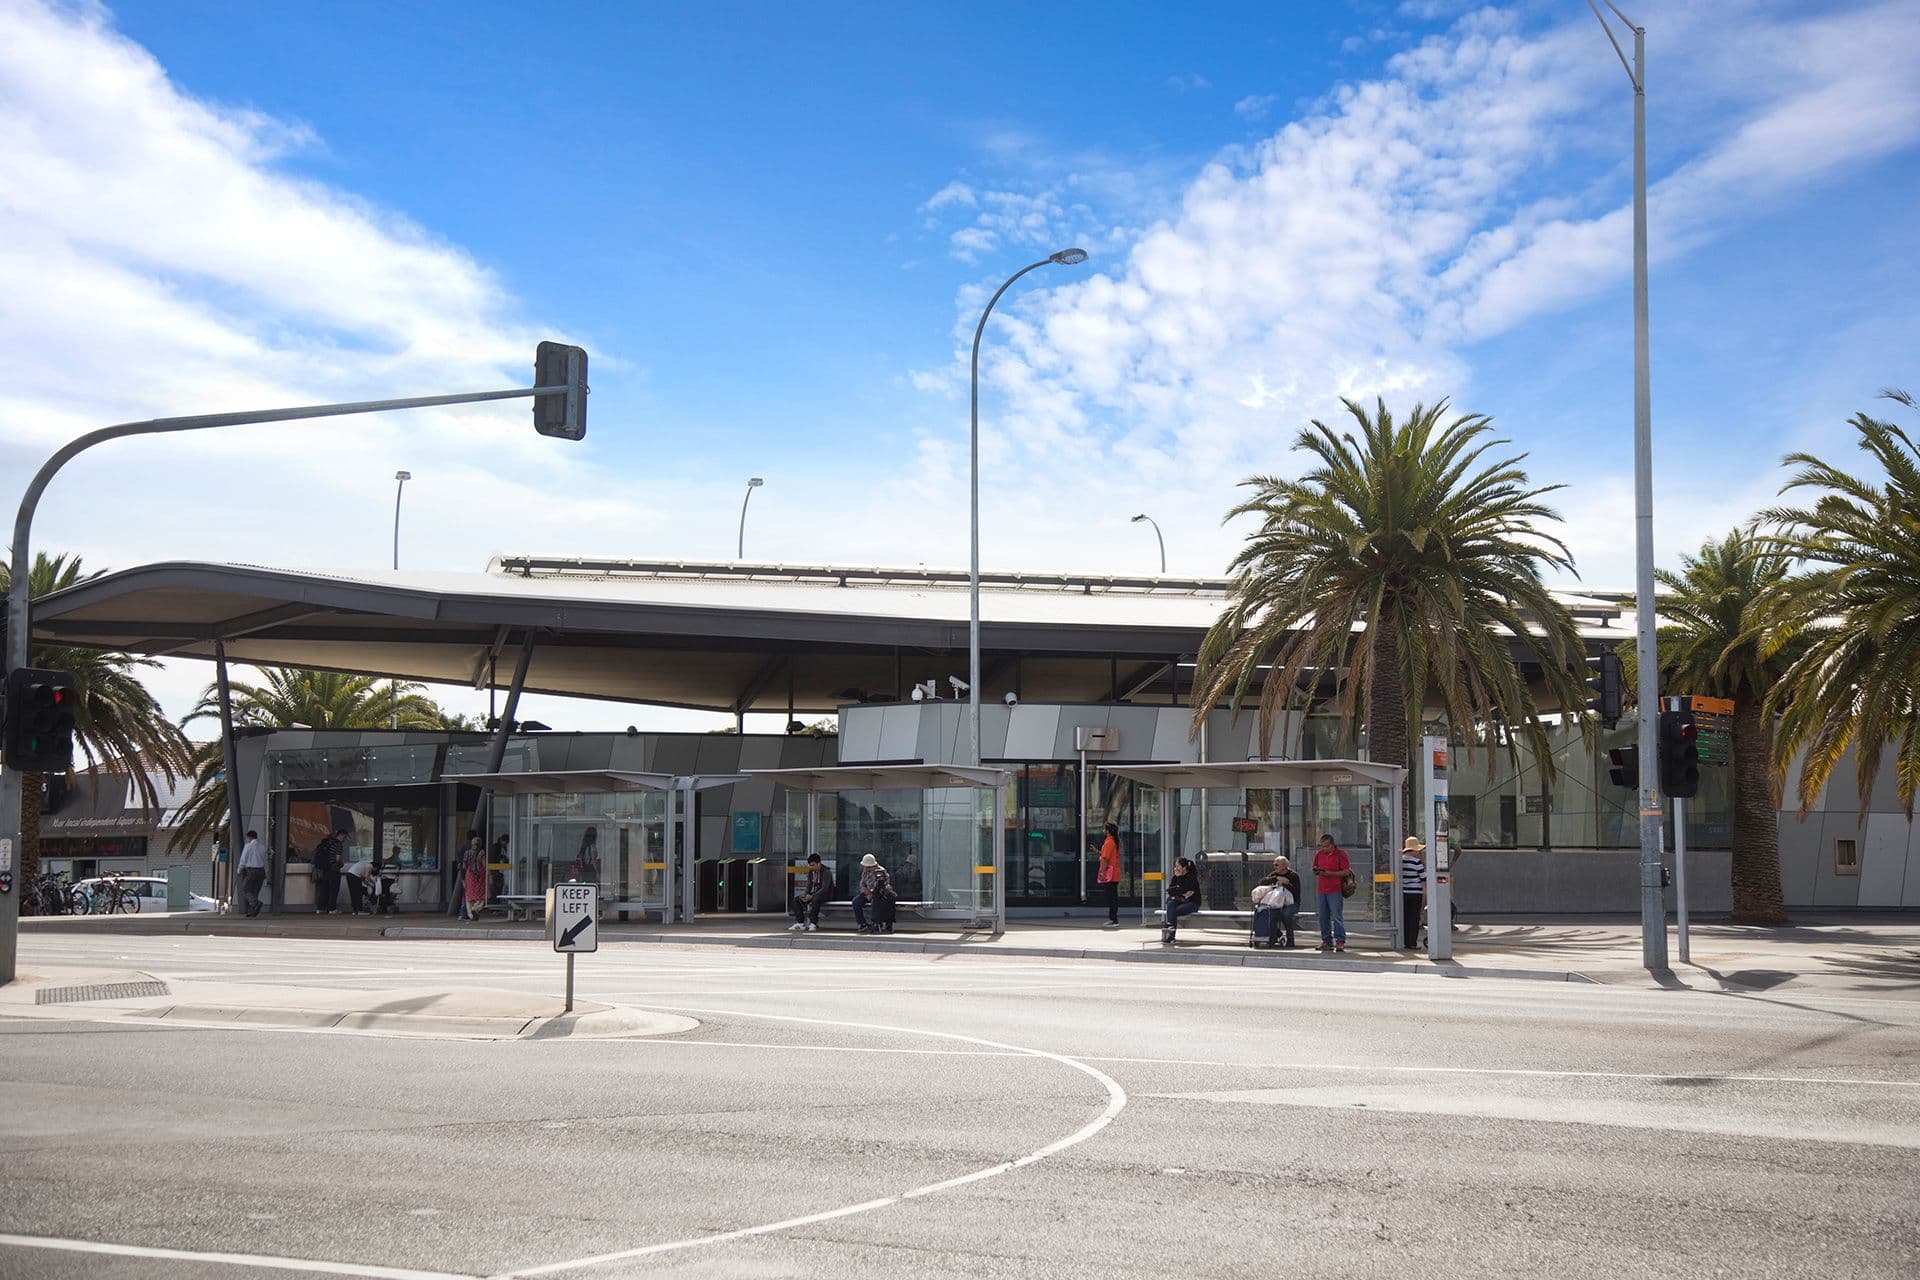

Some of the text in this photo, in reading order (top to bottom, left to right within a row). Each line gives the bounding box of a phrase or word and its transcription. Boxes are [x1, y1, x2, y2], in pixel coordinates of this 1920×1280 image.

[66, 817, 80, 827] local
[80, 816, 117, 828] independent
[1234, 820, 1256, 831] OPEN
[562, 889, 590, 899] KEEP
[563, 903, 588, 913] LEFT
